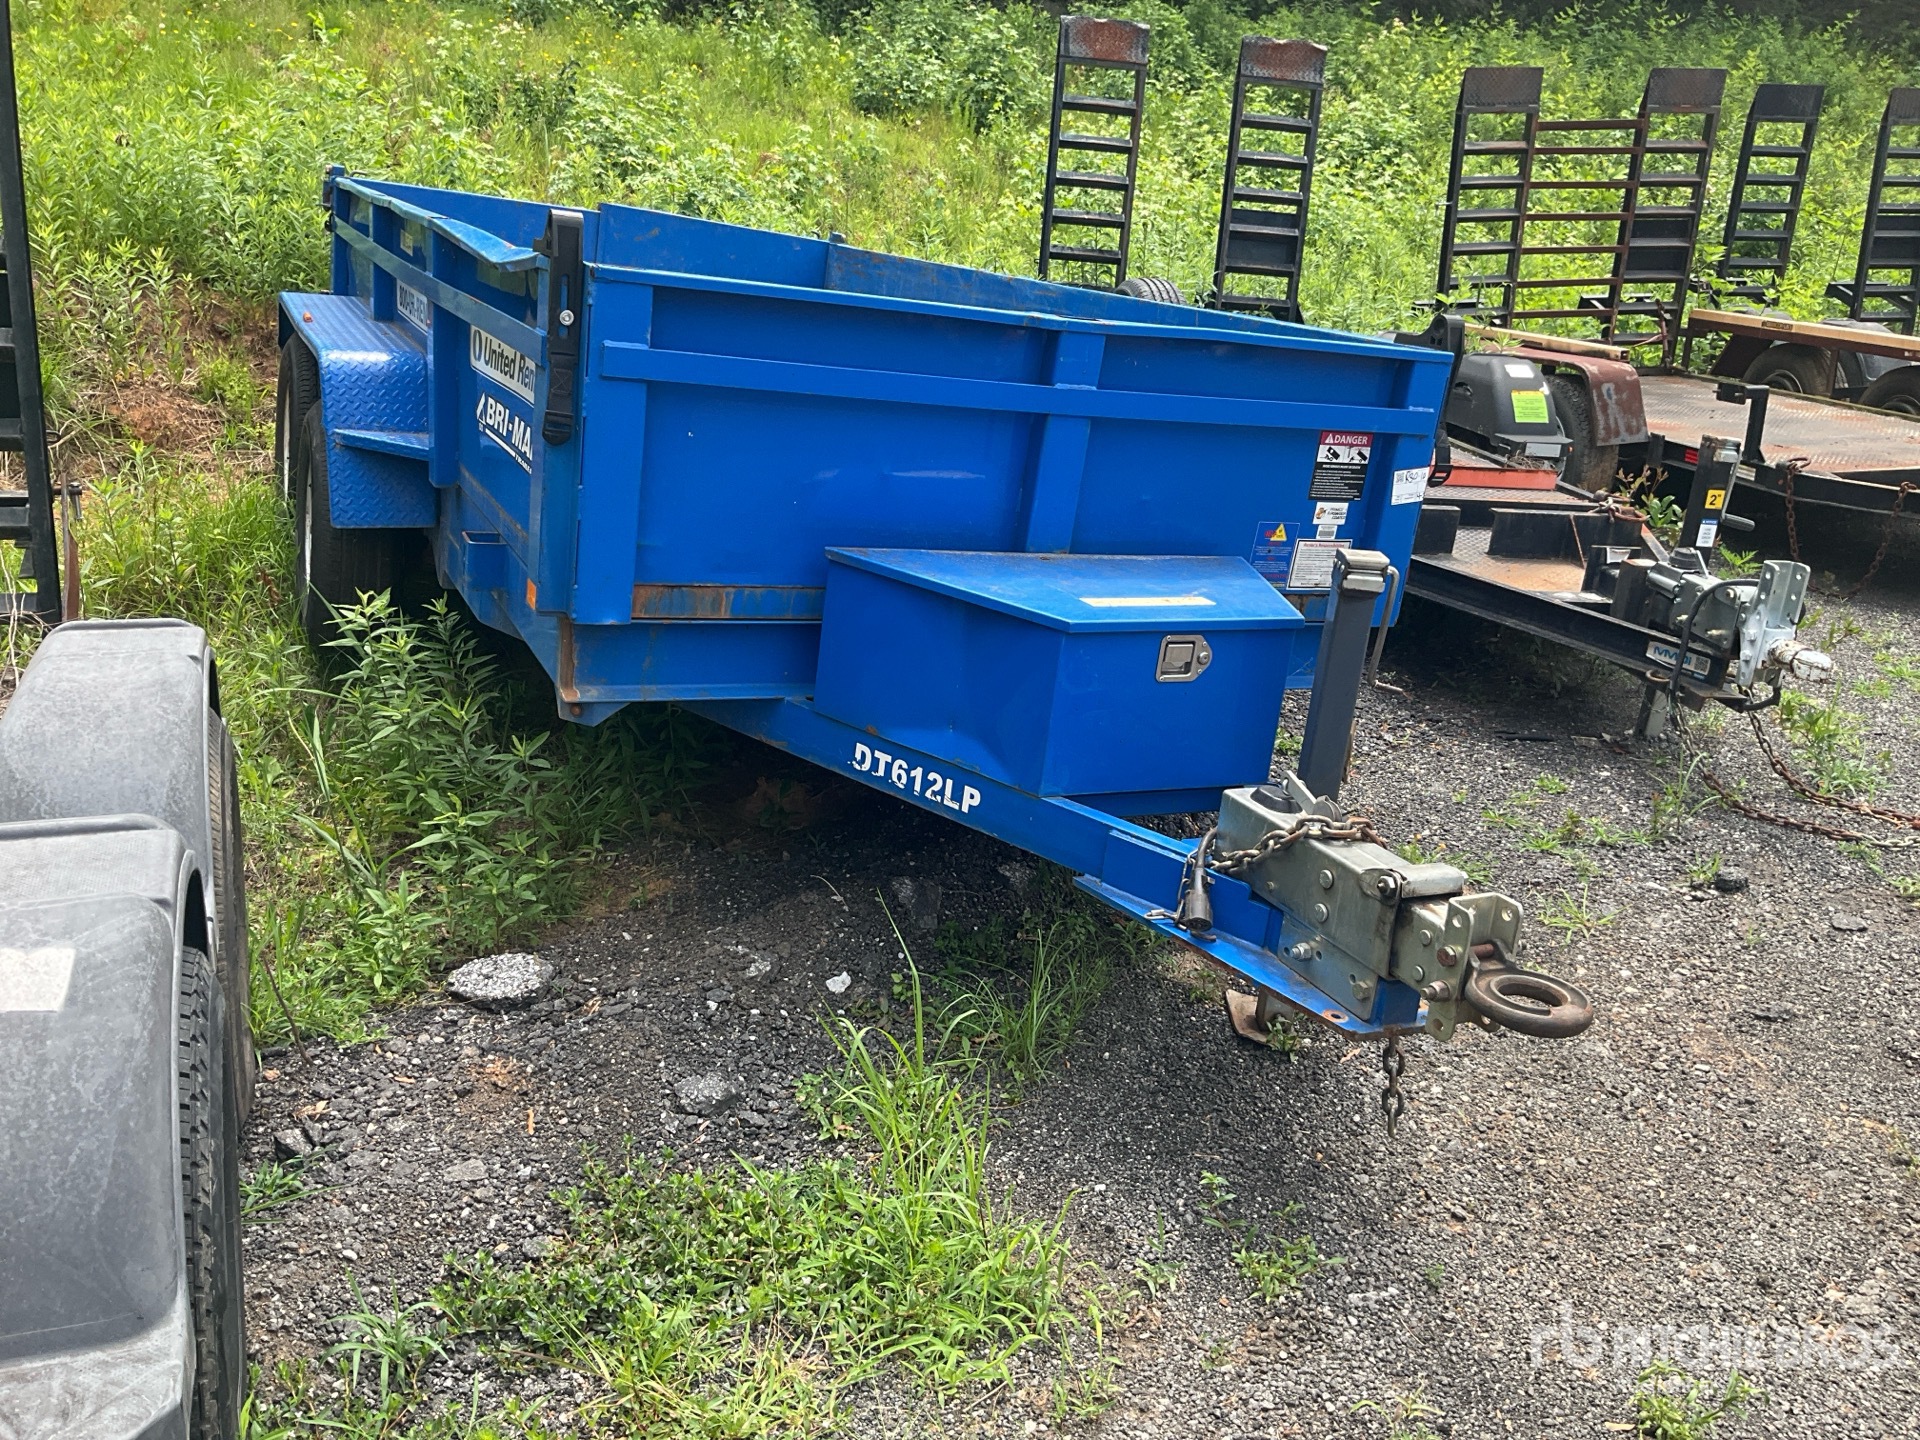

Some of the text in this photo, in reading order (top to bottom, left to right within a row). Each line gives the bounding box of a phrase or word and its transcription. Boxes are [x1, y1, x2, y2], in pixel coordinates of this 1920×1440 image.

[484, 336, 517, 380] United
[486, 396, 533, 461] BRI-MA
[1334, 434, 1368, 445] DANGER
[1709, 494, 1722, 506] 2"
[850, 742, 981, 814] DT612LP
